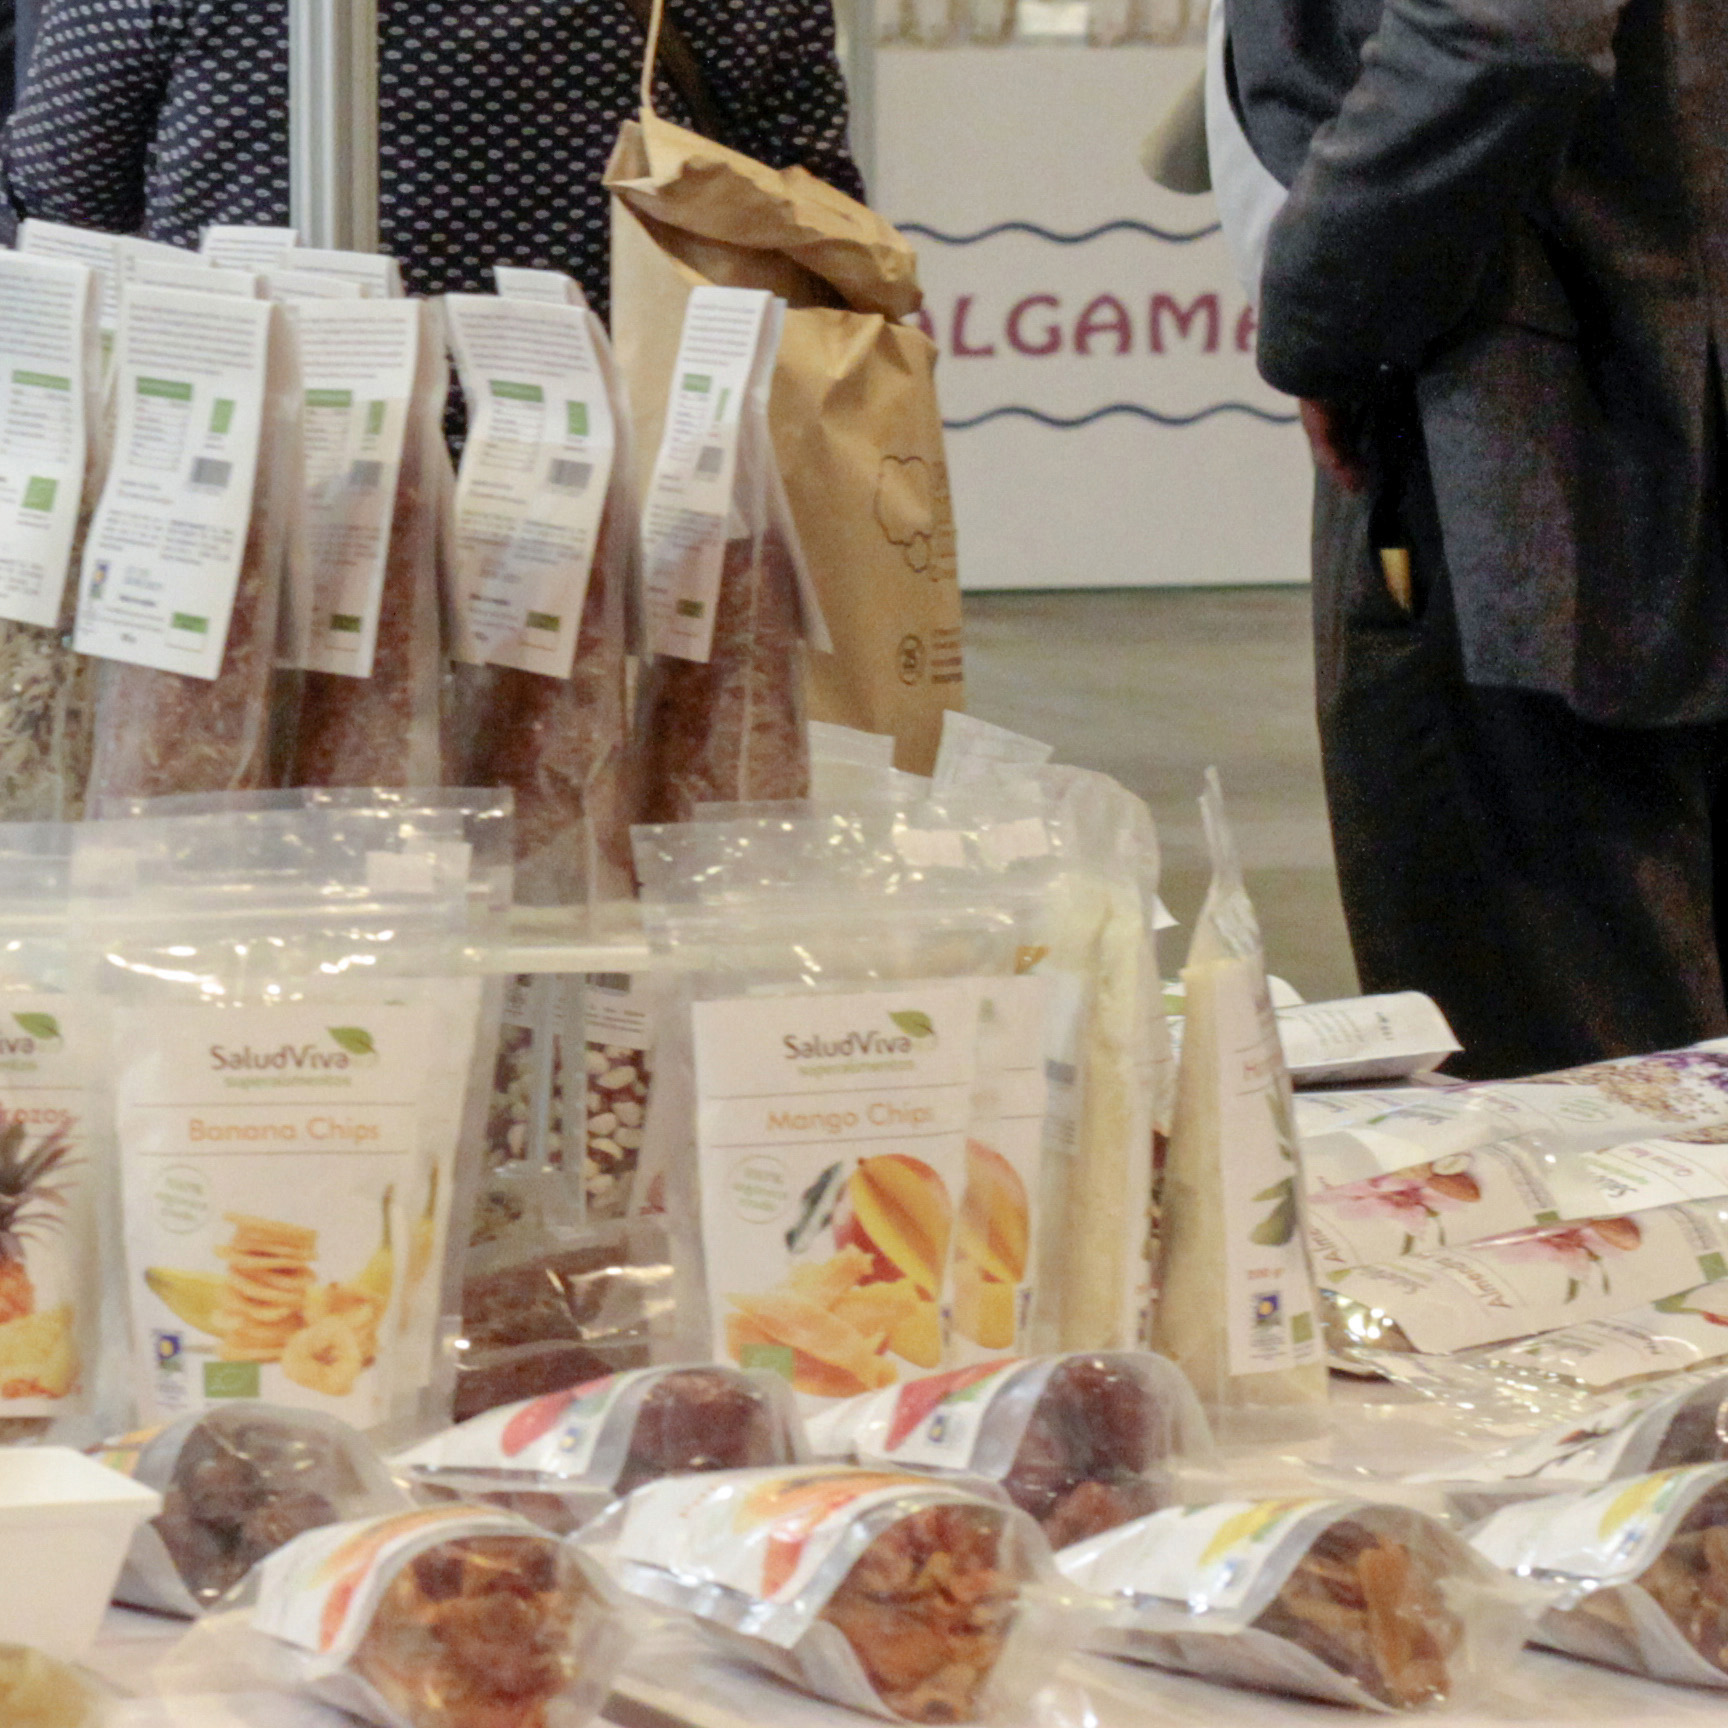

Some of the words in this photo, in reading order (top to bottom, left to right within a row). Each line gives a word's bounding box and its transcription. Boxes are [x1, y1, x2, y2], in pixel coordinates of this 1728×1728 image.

[209, 1043, 350, 1071] SaludViva
[783, 1030, 913, 1060] SaludViva
[189, 1118, 298, 1142] Banana
[305, 1116, 380, 1144] Chips
[766, 1111, 859, 1134] Mango
[866, 1102, 935, 1127] Chips
